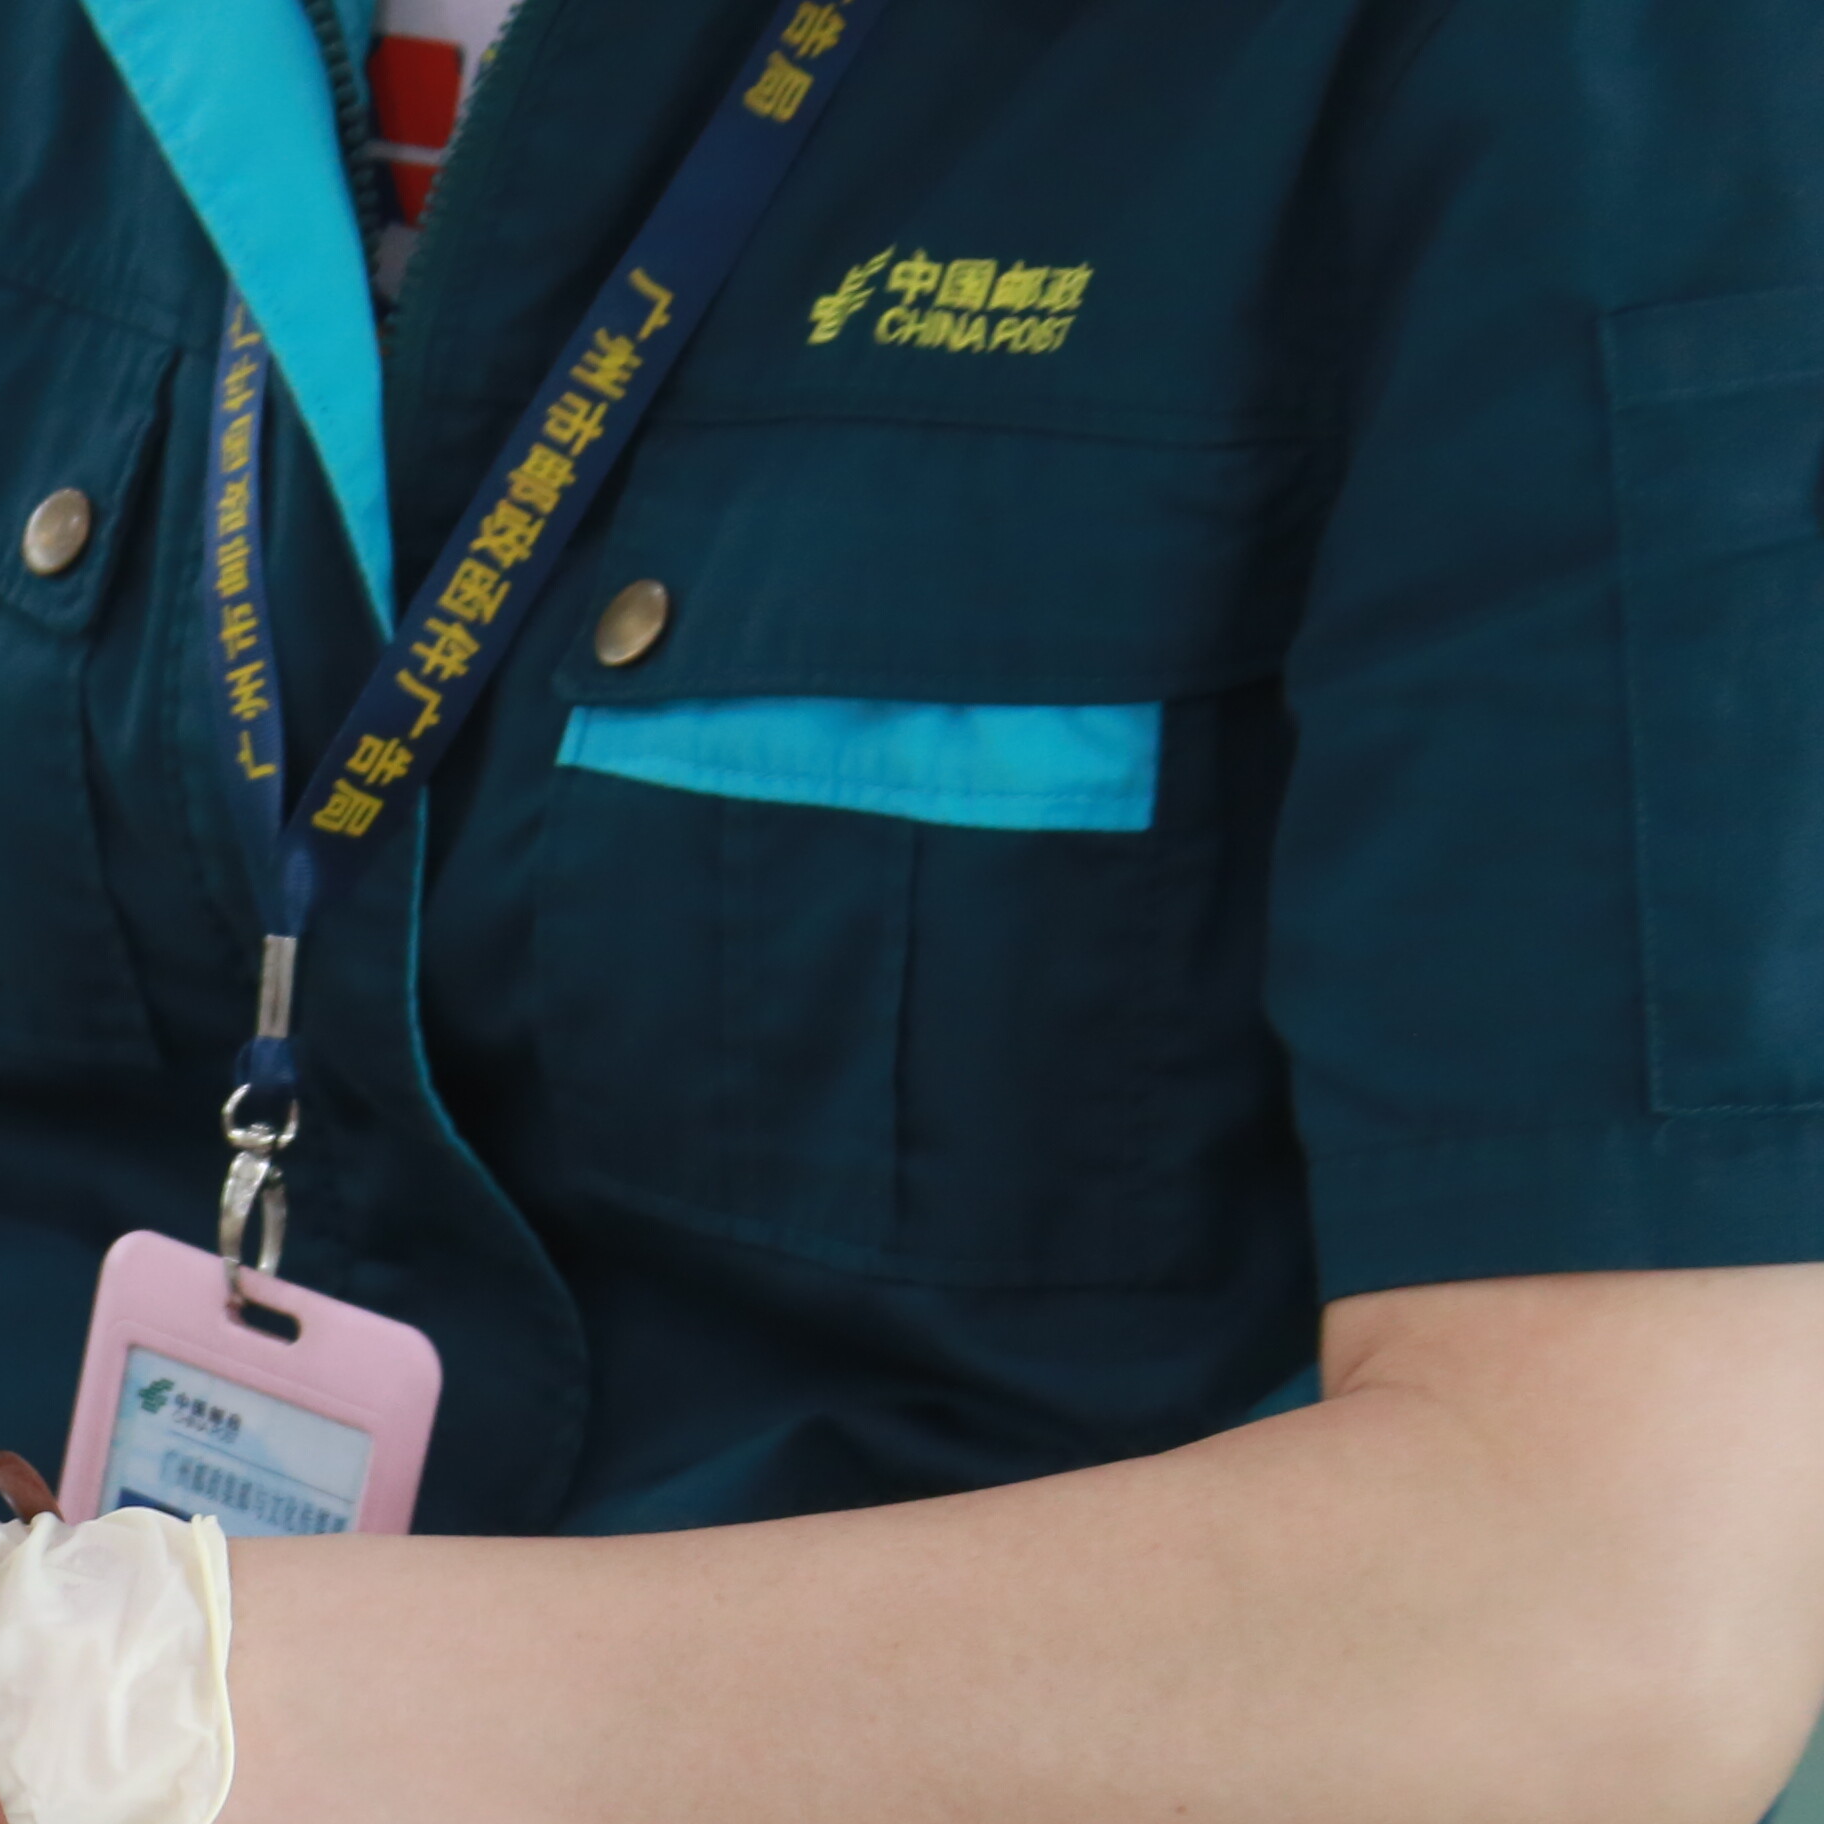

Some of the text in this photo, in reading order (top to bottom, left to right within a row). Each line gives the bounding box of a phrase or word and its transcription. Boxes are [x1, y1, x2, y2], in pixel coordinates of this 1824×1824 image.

[742, 0, 852, 123] 告局
[886, 248, 1094, 312] 中国邮政
[874, 305, 1076, 354] CHINA POST
[312, 267, 674, 837] 广州市邮政函件广告局
